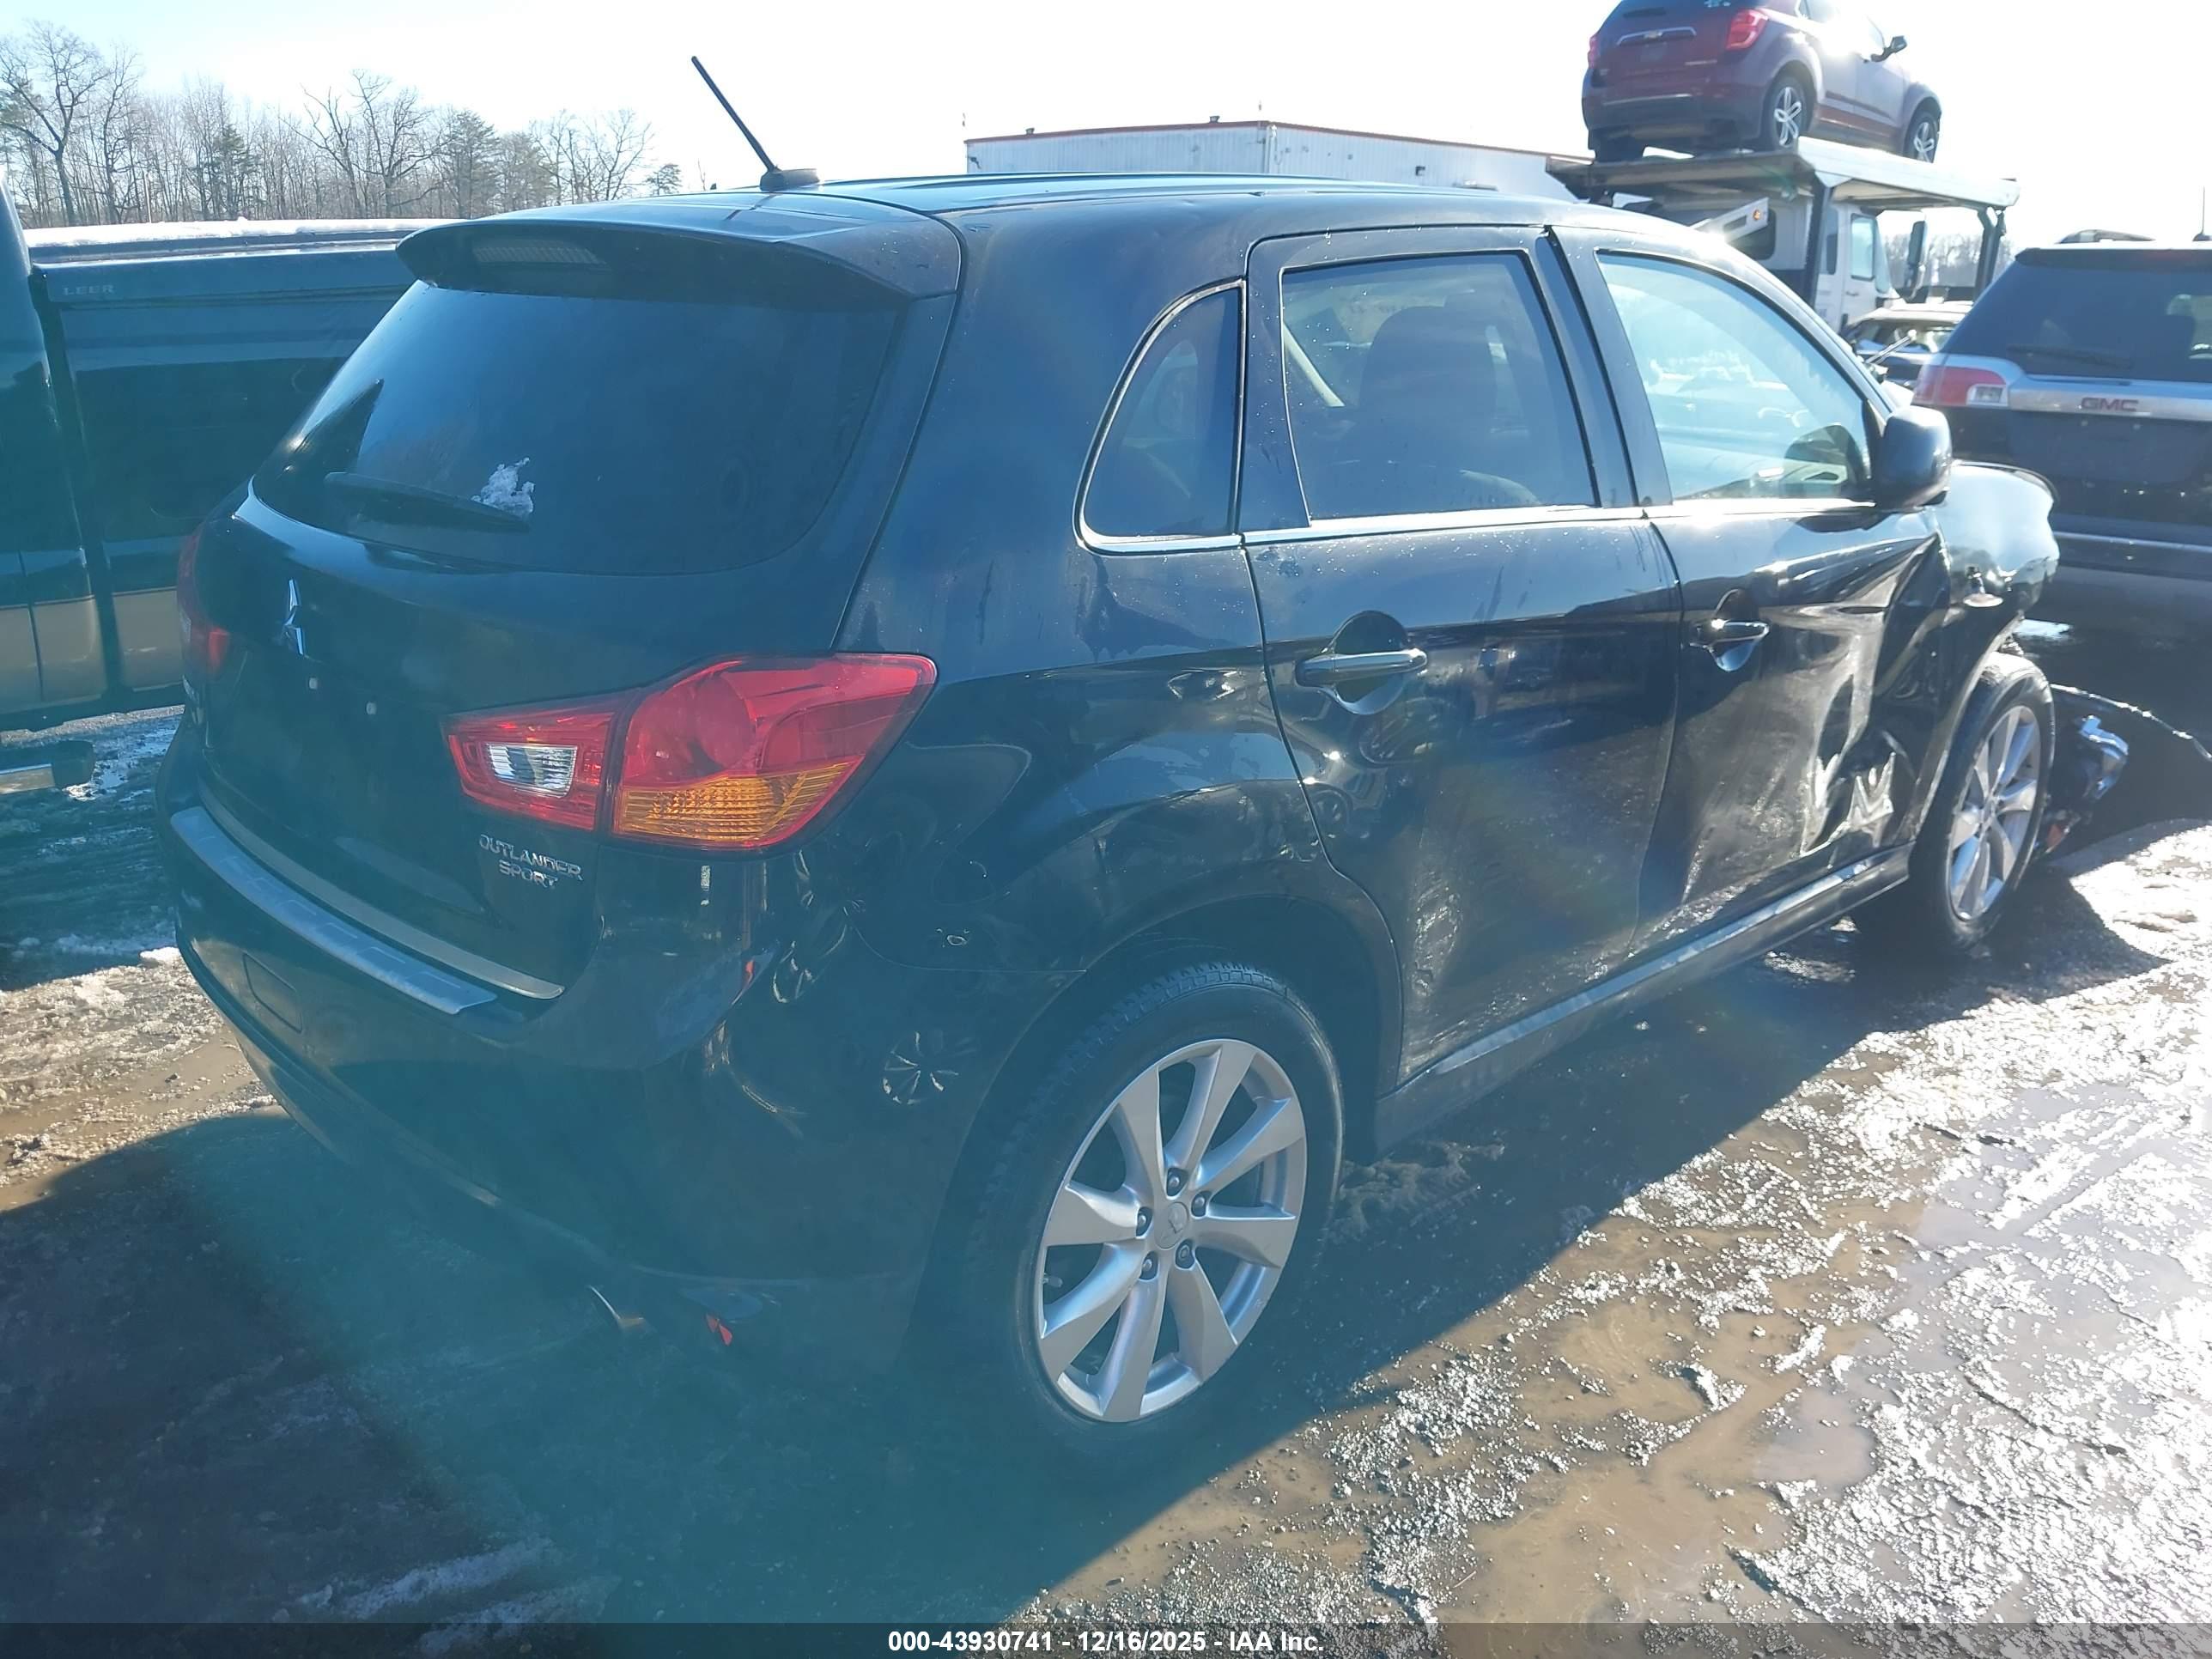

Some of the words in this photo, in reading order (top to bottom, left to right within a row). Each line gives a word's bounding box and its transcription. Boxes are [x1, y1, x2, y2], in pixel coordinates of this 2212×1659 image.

[64, 283, 115, 295] LEER
[2081, 397, 2139, 412] GMC
[479, 834, 584, 881] OUTLANDER
[498, 860, 558, 888] SPORT
